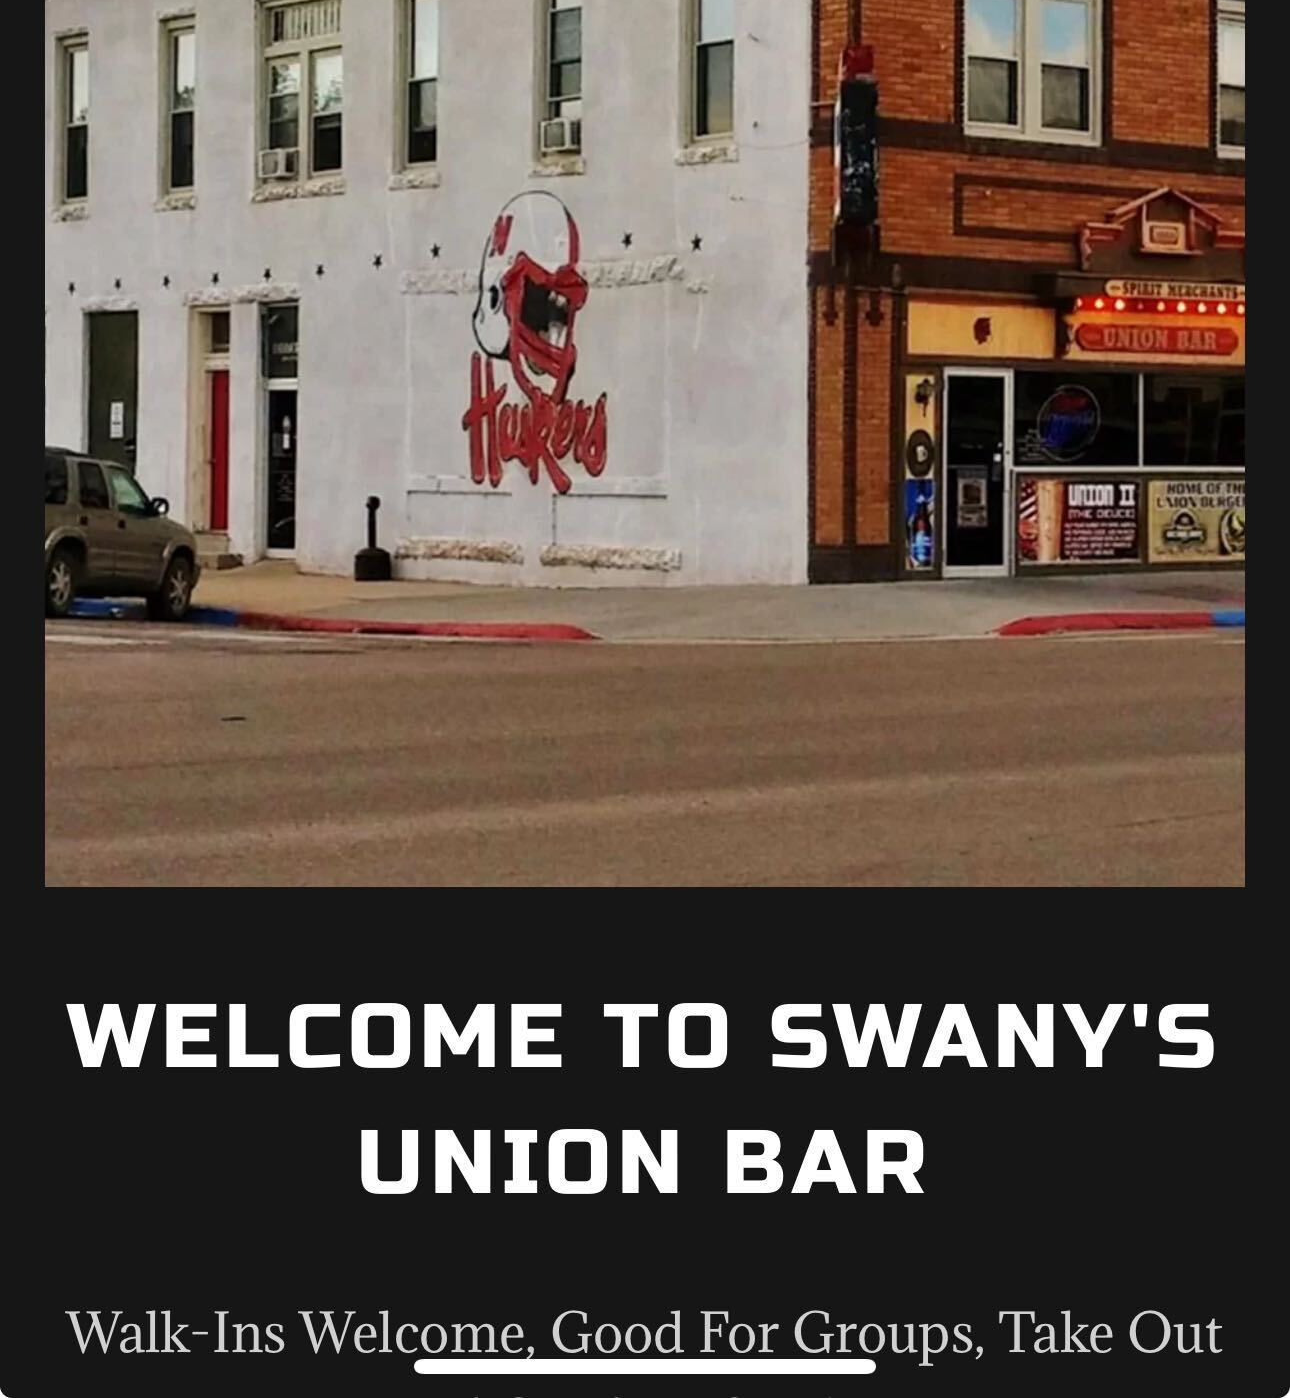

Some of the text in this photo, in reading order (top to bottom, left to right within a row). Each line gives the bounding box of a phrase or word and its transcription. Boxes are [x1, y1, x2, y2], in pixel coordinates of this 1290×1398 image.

[1122, 282, 1238, 299] SPIRIT MERCHANTS
[1103, 328, 1217, 350] UNION BAR
[66, 1003, 1215, 1069] WELCOME TO SWANY'S
[360, 1129, 925, 1195] UNION BAR
[65, 1308, 1223, 1367] Walk-Ins Welcome, Good For Groups, Take Out
